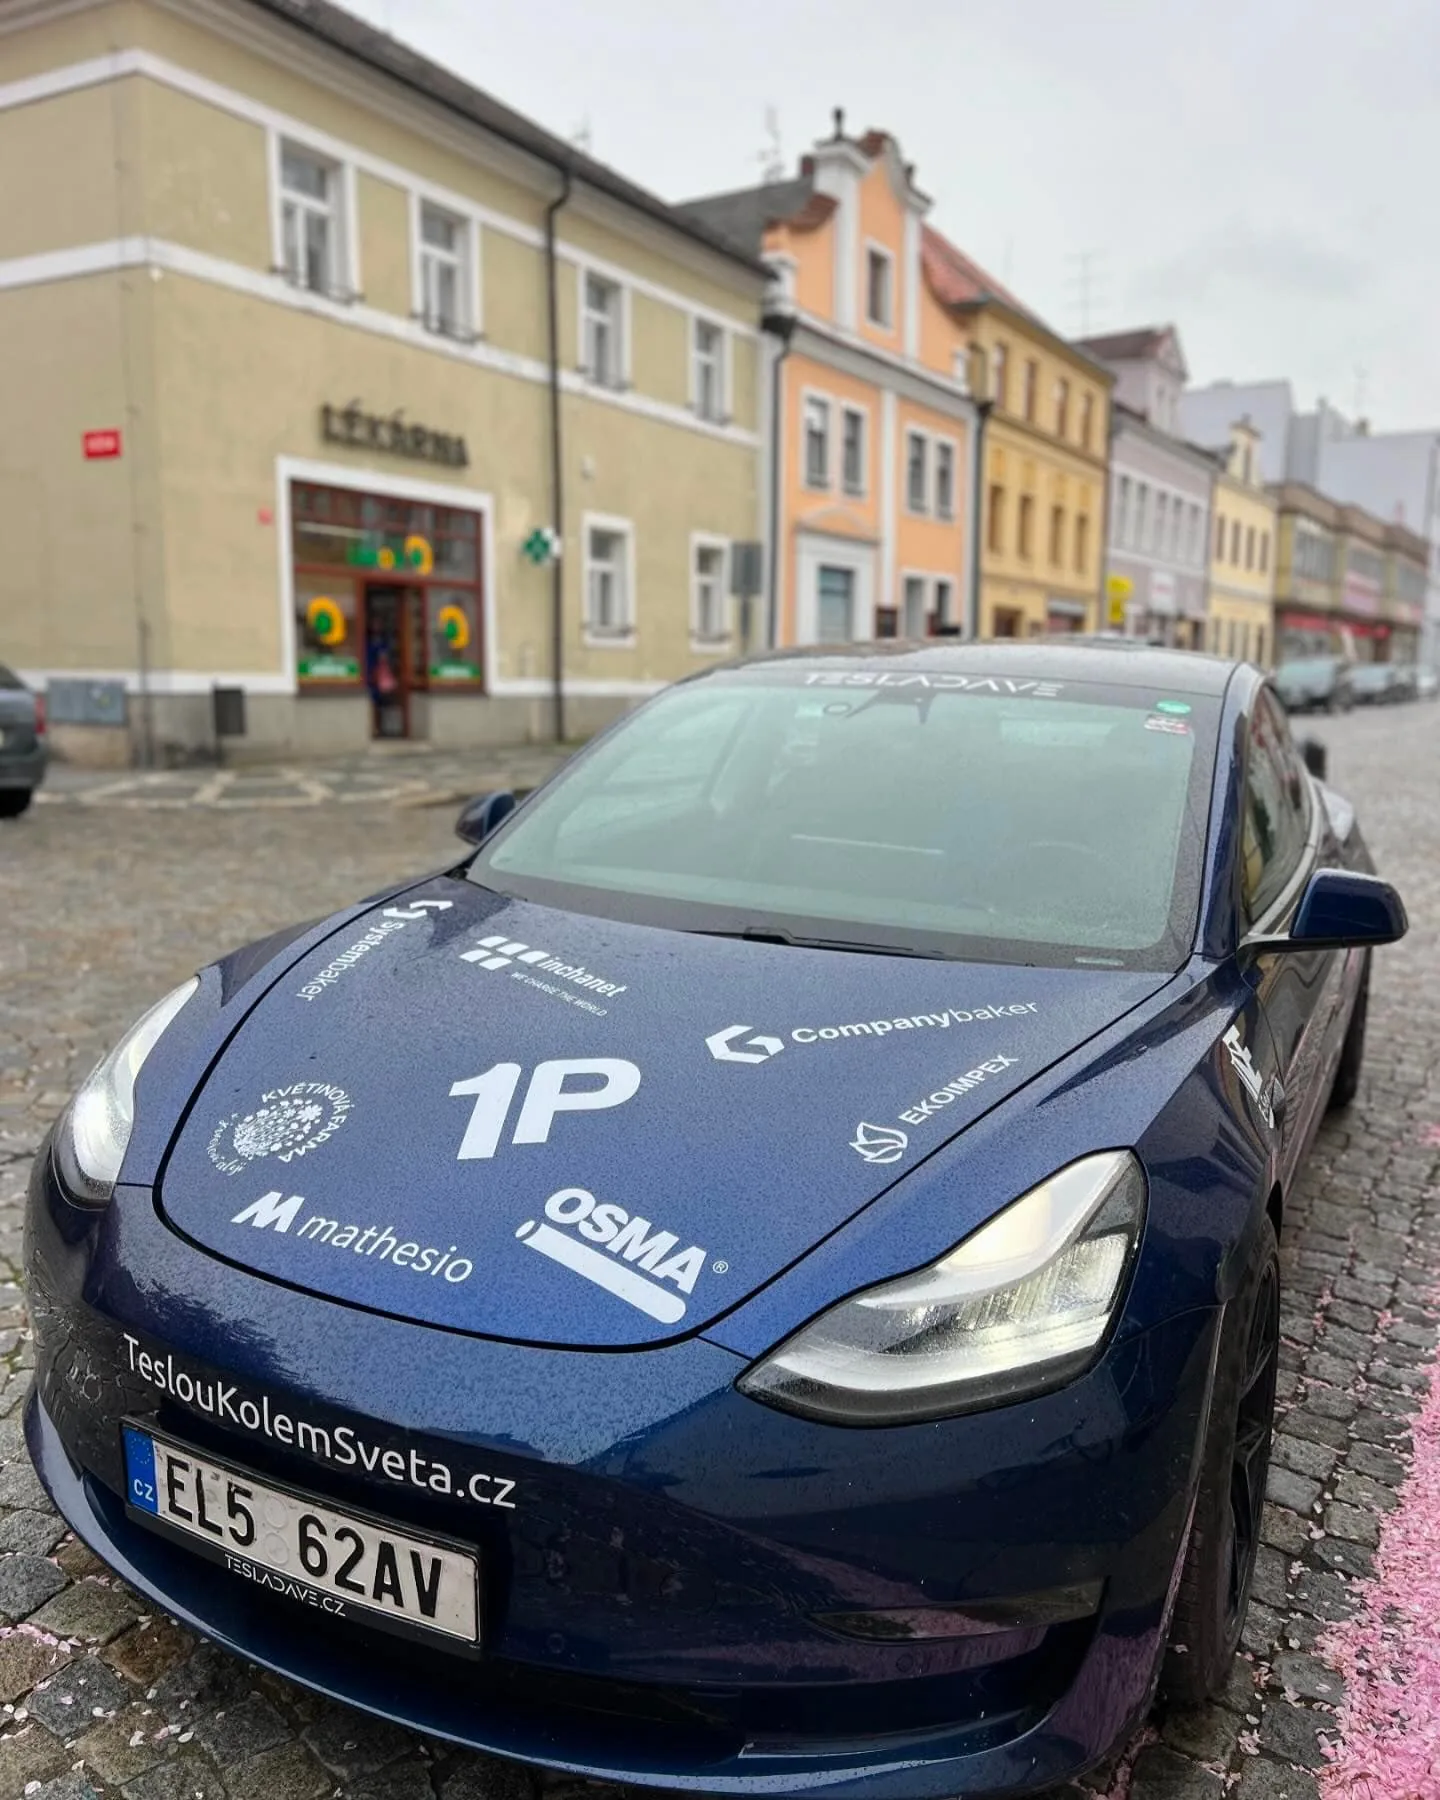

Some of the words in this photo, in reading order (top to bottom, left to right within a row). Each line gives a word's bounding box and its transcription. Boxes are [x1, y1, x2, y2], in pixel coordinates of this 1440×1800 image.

[804, 672, 1064, 698] TESLADAVE
[296, 920, 406, 1001] systembaker
[536, 956, 628, 998] inchanet
[791, 1001, 1038, 1043] Companybaker
[448, 1058, 641, 1160] 1P
[898, 1054, 1019, 1125] EKOIMPEX
[278, 1114, 348, 1163] FARMA
[296, 1215, 474, 1282] mathesio
[122, 1333, 517, 1509] TeslouKolemSveta.cz
[133, 1478, 155, 1503] CZ
[166, 1453, 256, 1547] EL5
[298, 1513, 444, 1619] 62AV
[224, 1552, 347, 1618] TESLADAVE.CZ
